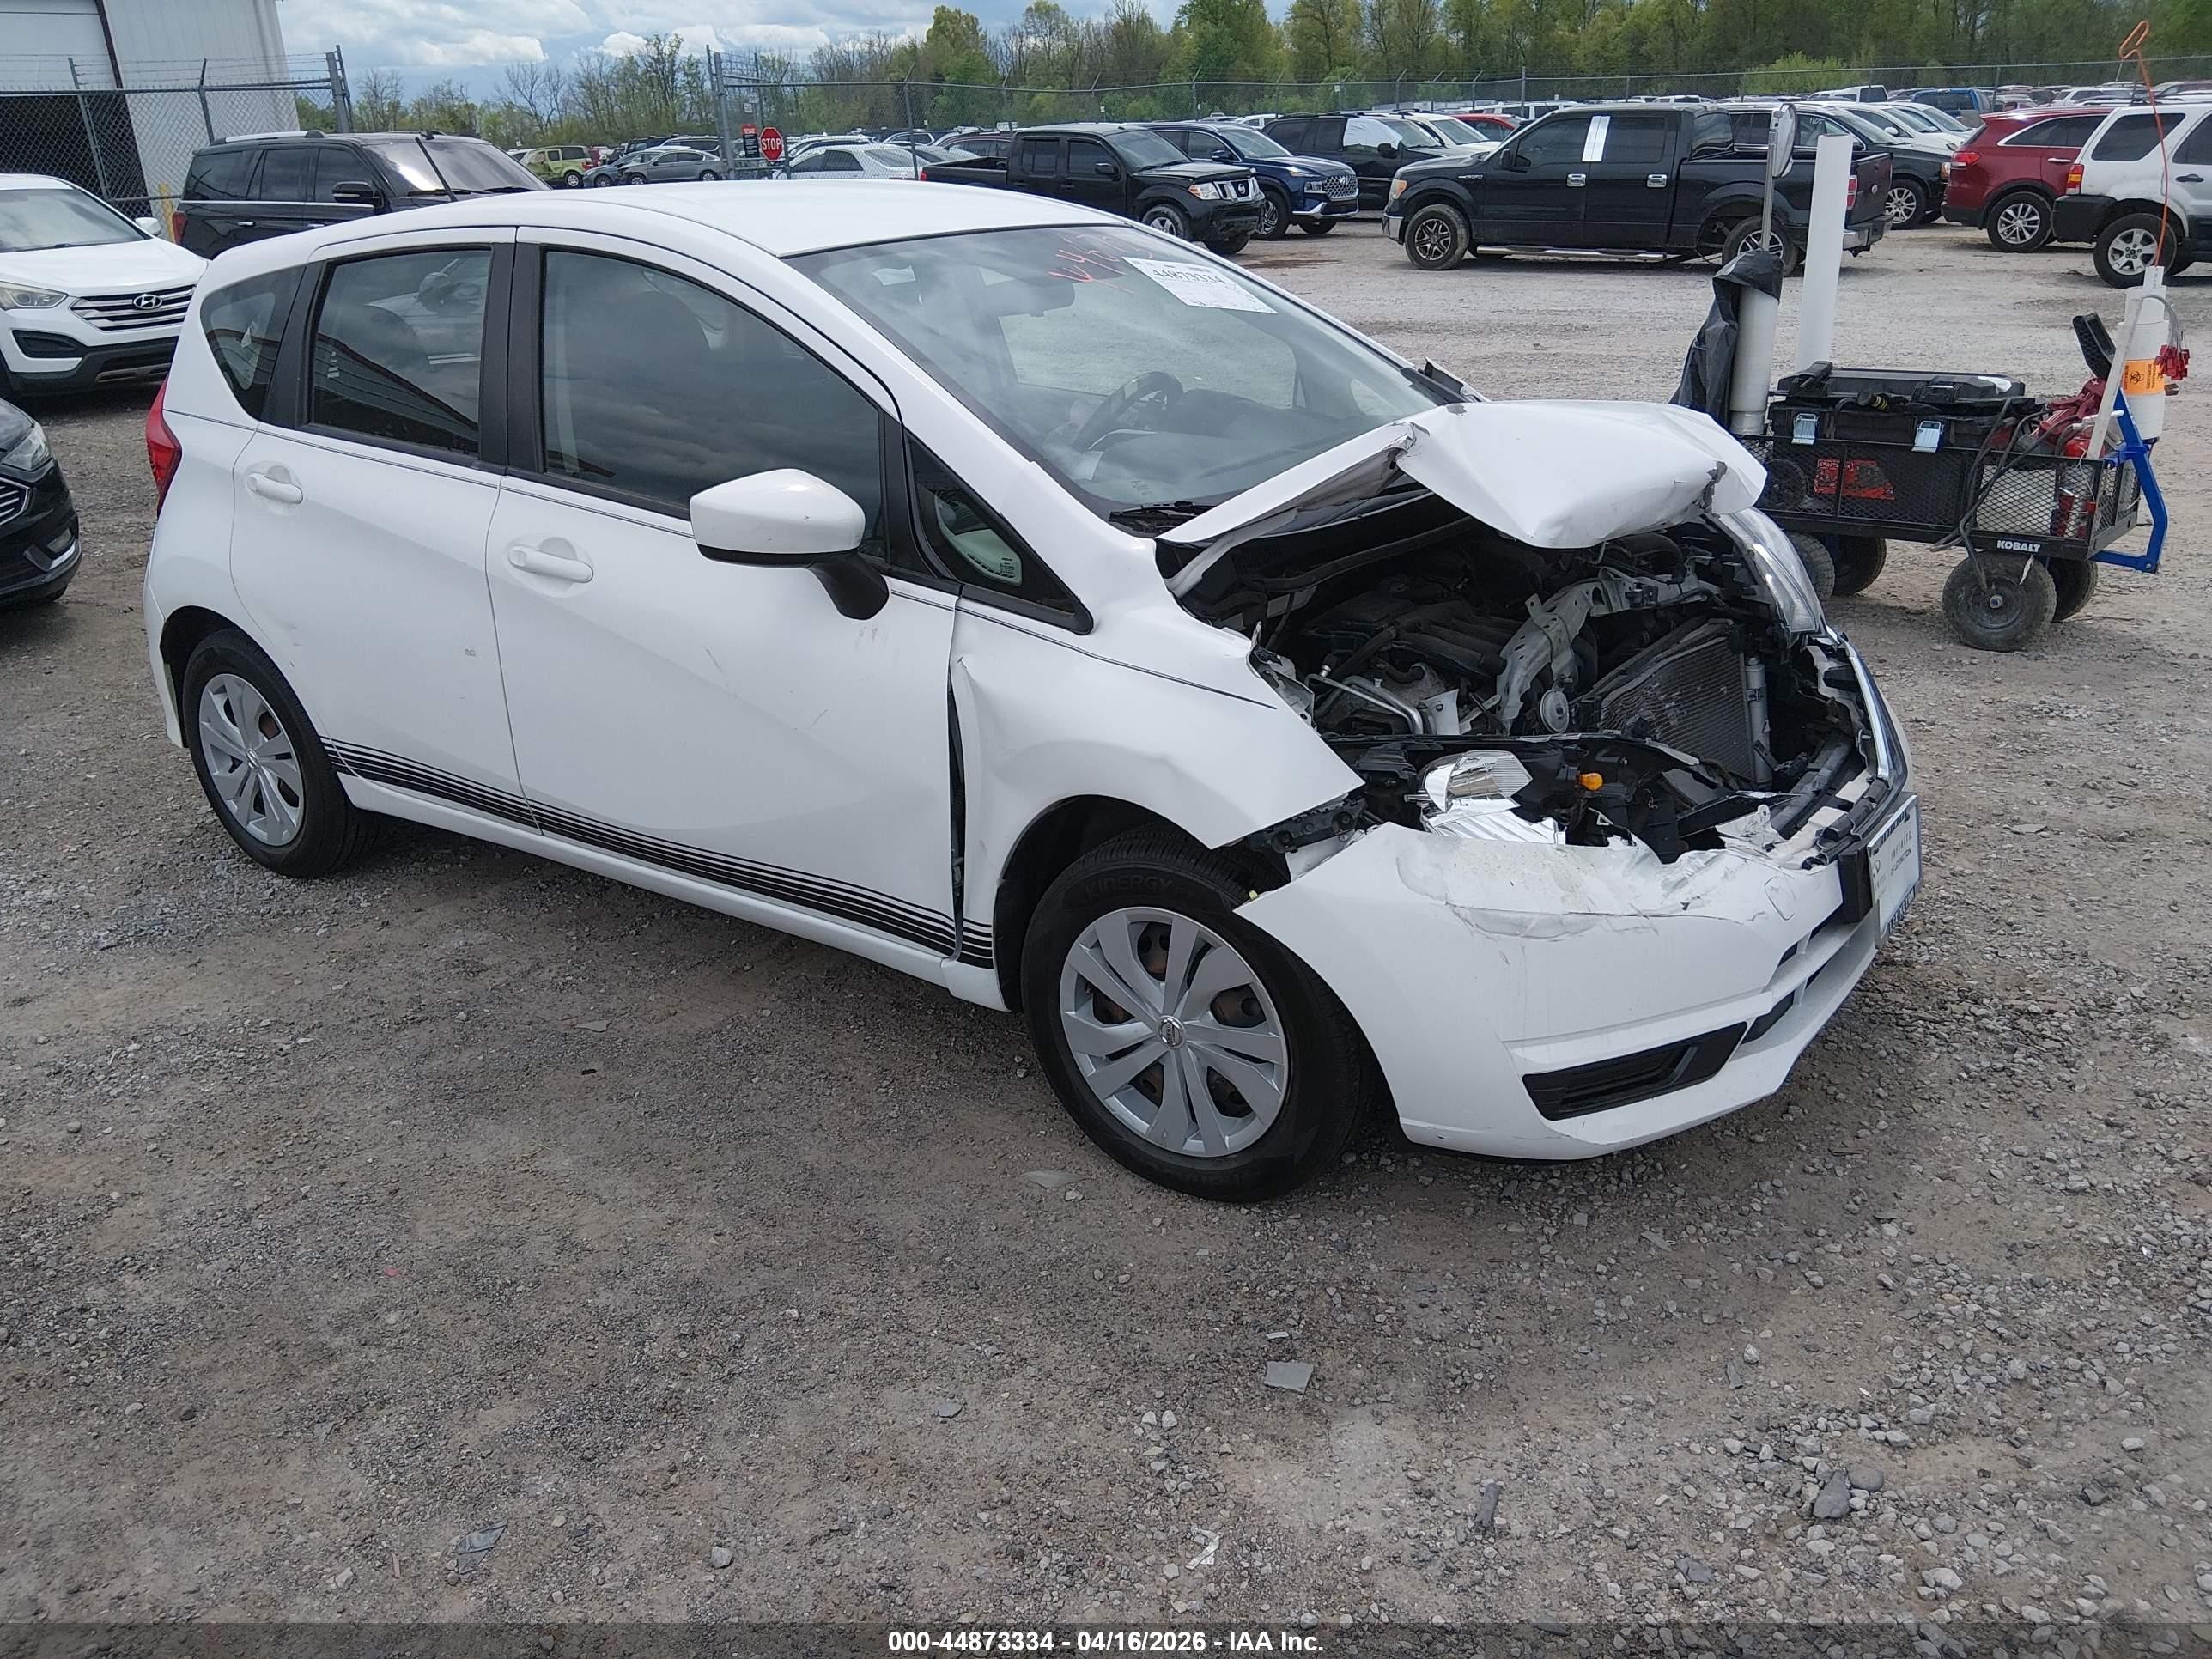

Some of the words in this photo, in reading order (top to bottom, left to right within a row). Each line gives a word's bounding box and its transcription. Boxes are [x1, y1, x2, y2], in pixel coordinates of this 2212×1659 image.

[761, 137, 781, 151] STOP
[1152, 268, 1225, 285] 44873334
[1996, 539, 2041, 553] KOBALT
